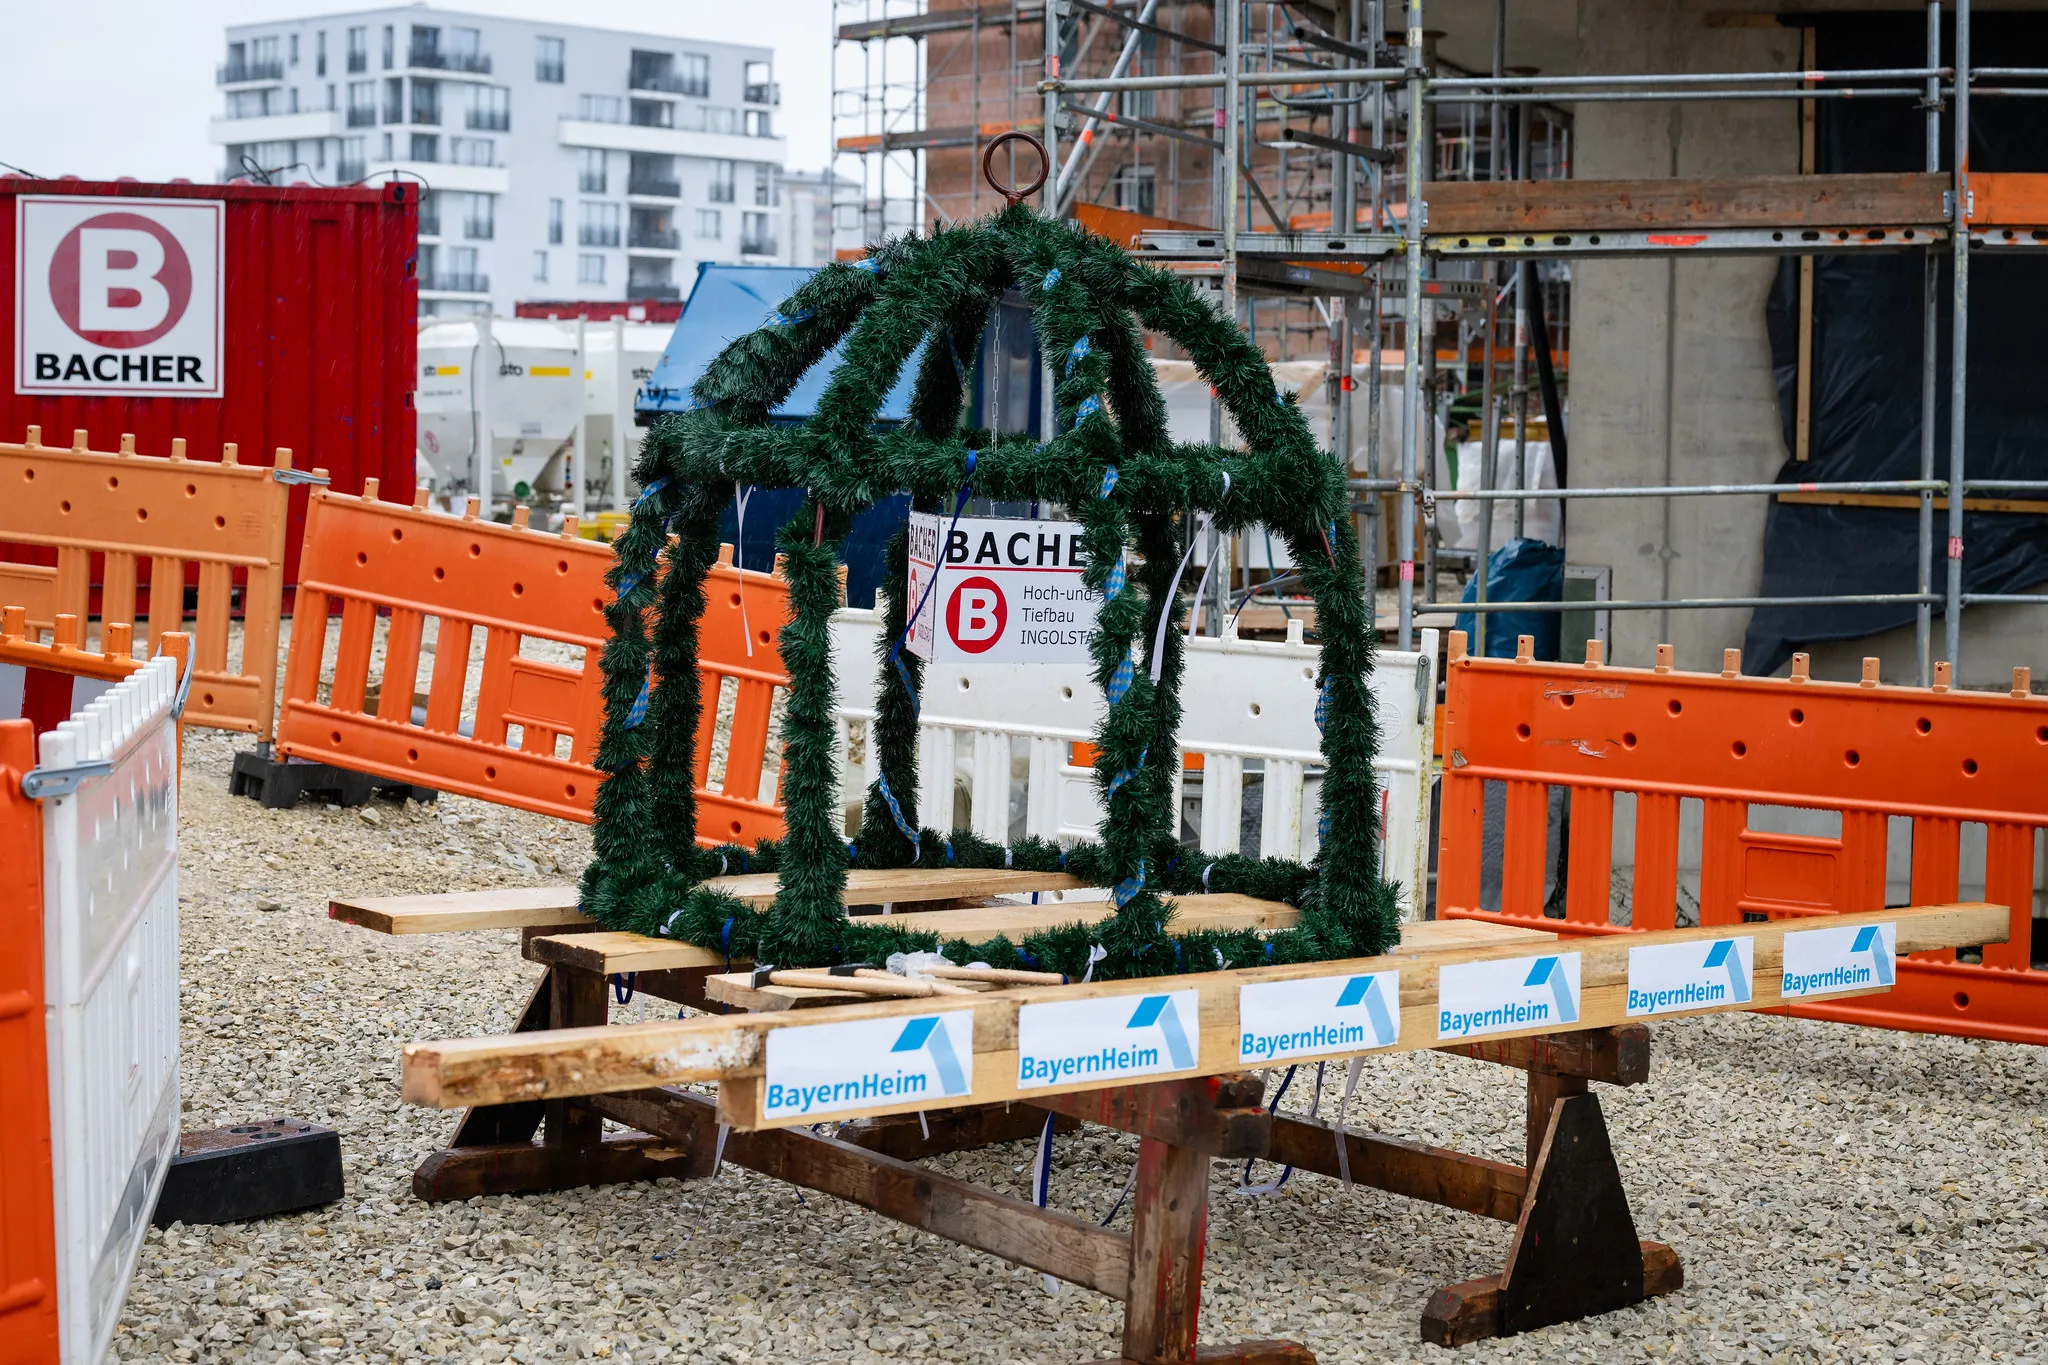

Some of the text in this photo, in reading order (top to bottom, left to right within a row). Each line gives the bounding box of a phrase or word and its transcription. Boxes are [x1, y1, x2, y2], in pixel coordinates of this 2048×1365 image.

[79, 228, 170, 332] B
[36, 353, 204, 383] BACHER
[499, 362, 523, 377] sto
[946, 530, 1089, 567] BACHE
[958, 587, 998, 641] B
[1022, 607, 1074, 623] Tiefbau
[1020, 630, 1094, 645] INGOLSTA
[1783, 966, 1871, 995] BayernHeim
[1627, 983, 1725, 1013] BayernHeim
[1439, 1002, 1549, 1036] BayernHeim
[1241, 1021, 1364, 1059] BayernHeim
[1020, 1045, 1159, 1084] BayernHeim
[767, 1069, 927, 1113] BayernHeim
